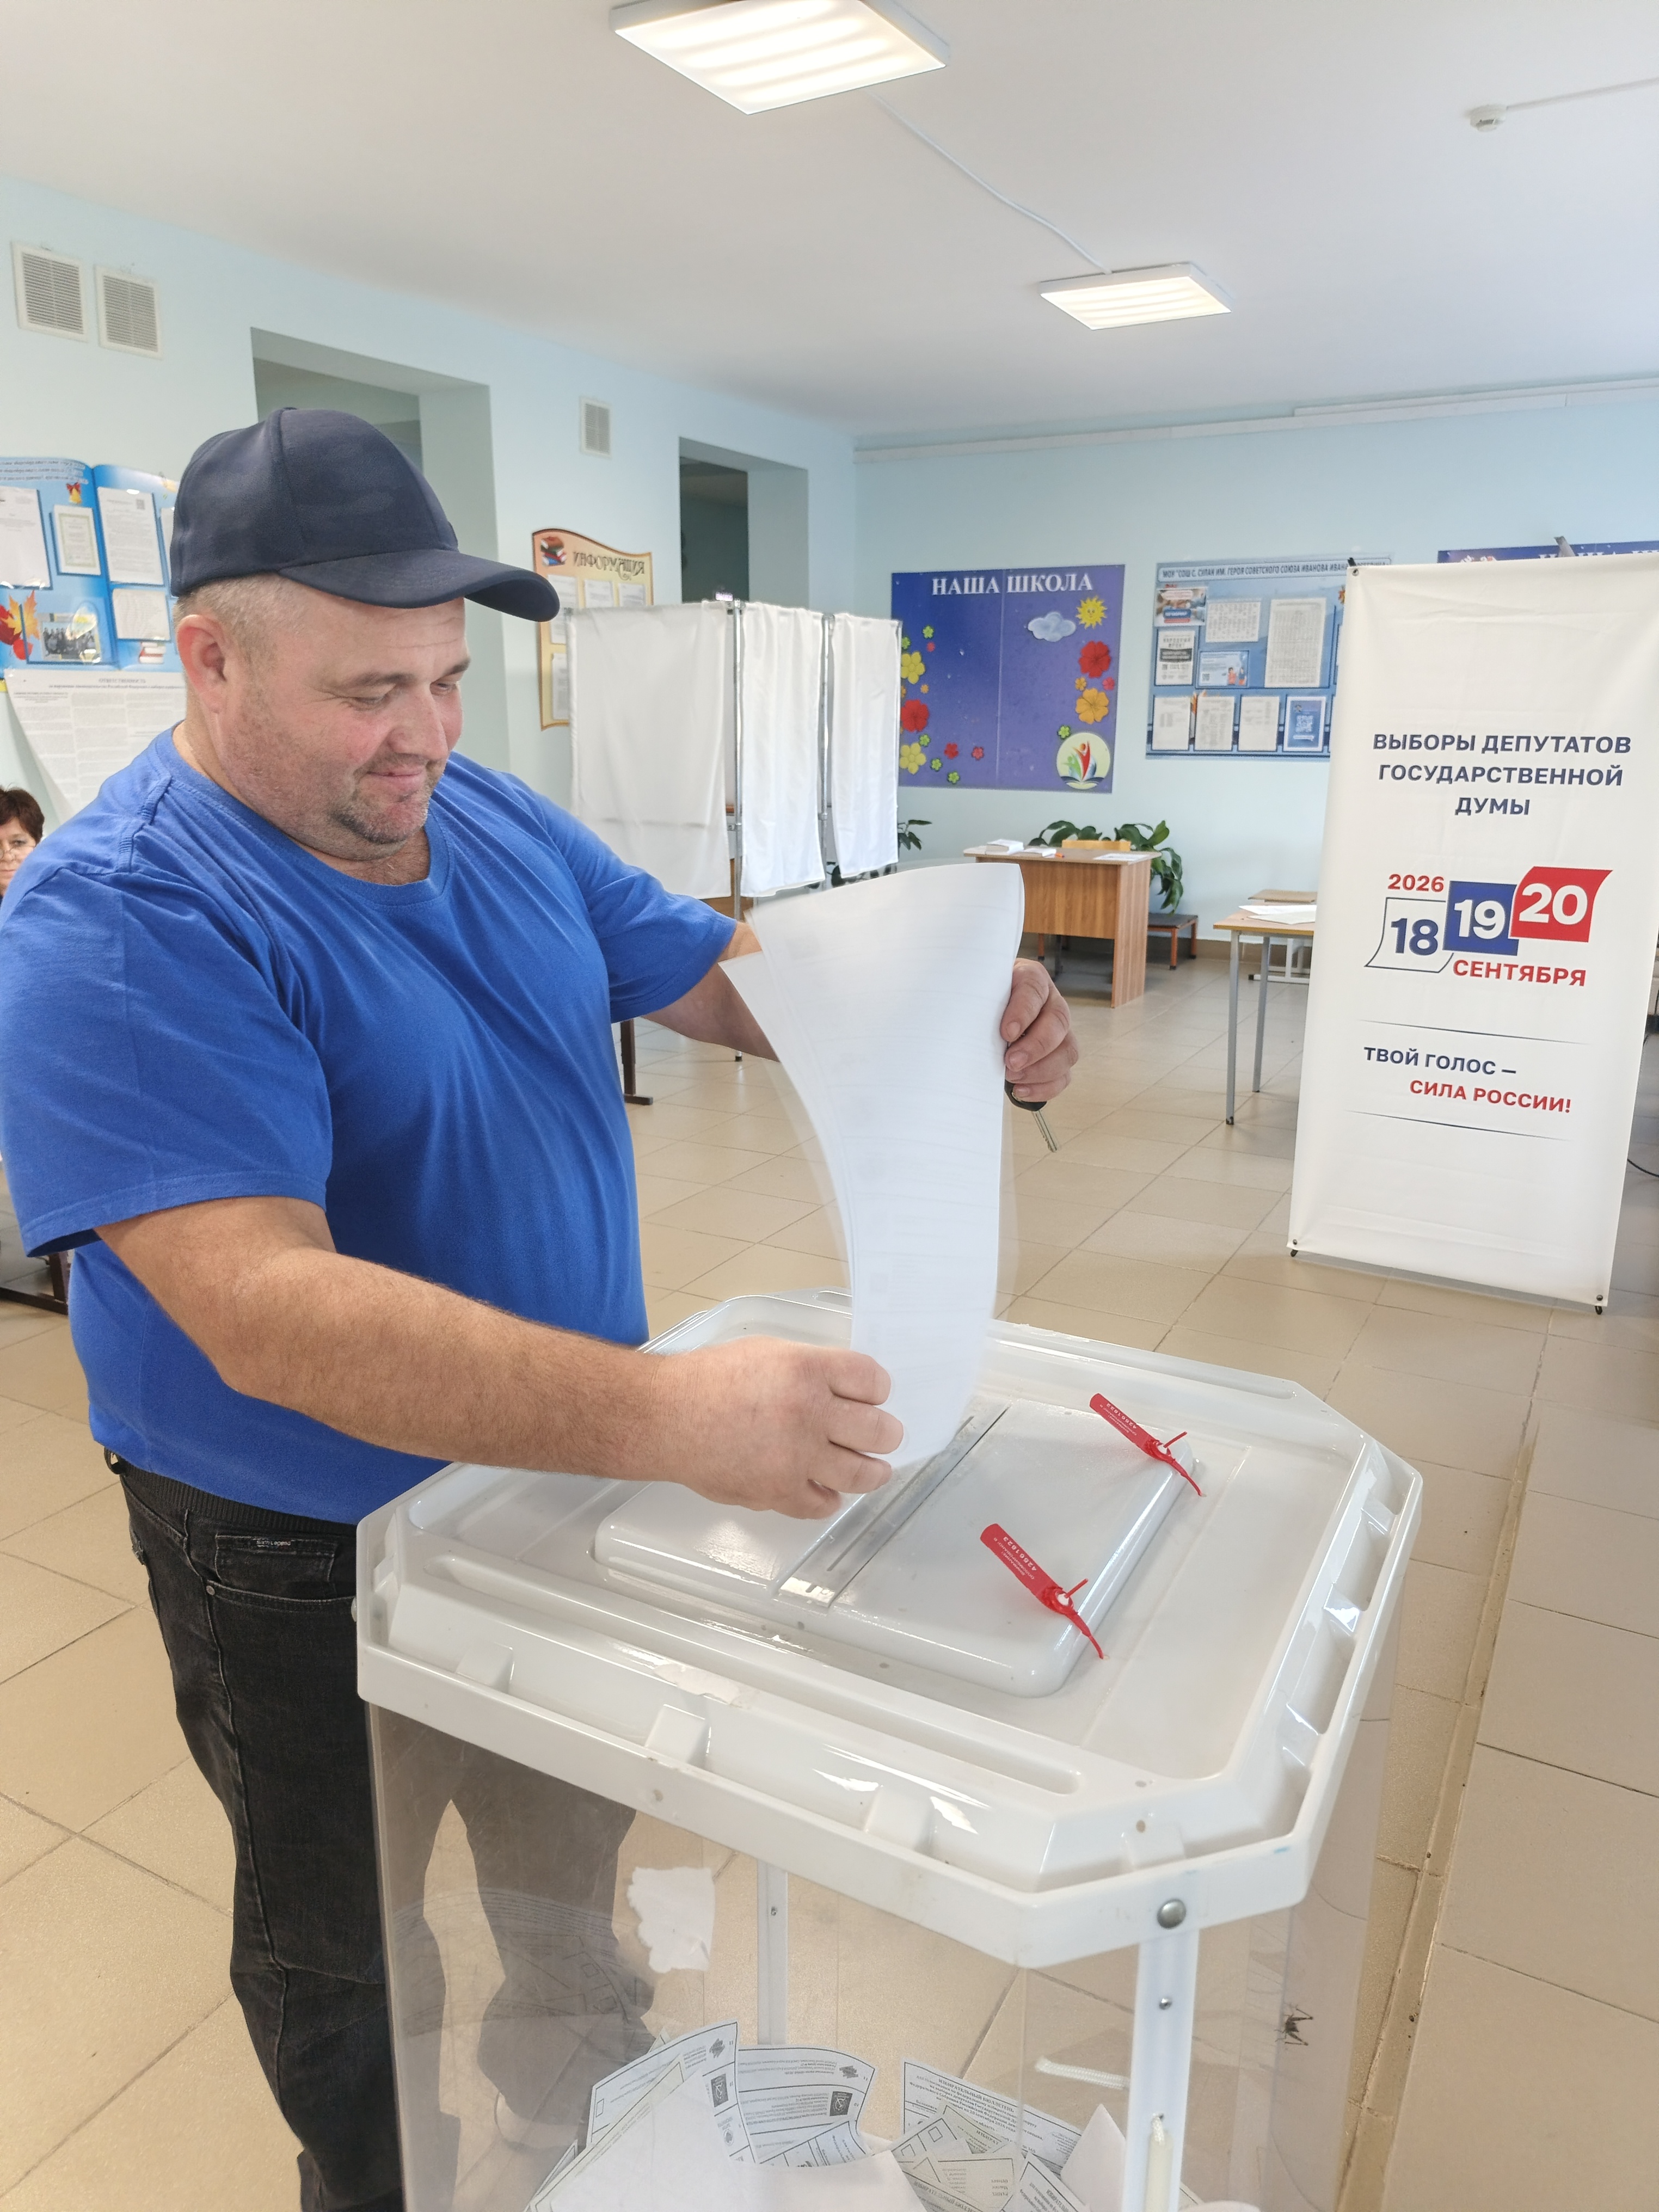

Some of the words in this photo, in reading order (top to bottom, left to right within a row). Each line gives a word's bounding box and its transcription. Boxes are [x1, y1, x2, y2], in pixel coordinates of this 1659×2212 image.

[573, 551, 644, 580] ИНФОРМАЦИЯ
[1227, 567, 1244, 575] ГЕРОЯ
[1245, 564, 1279, 575] СОВЕТСКОГО
[1280, 564, 1300, 574] СОЮЗА
[1301, 563, 1328, 573] ИВАНОВА
[932, 577, 1000, 595] НАША
[1007, 573, 1093, 593] ШКОЛА
[1373, 734, 1476, 751] ВЫБОРЫ
[1481, 735, 1631, 754] ДЕПУТАТОВ
[1379, 764, 1623, 786] ГОСУДАРСТВЕННОЙ
[1454, 797, 1530, 816] ДУМЫ
[1387, 874, 1445, 893] 2026
[1391, 918, 1439, 956] 18
[1454, 899, 1507, 940] 19
[1517, 883, 1588, 925] 20
[1453, 960, 1587, 986] СЕНТЯБРЯ
[1363, 1047, 1419, 1067] ТВОЙ
[1424, 1054, 1496, 1075] ГОЛОС
[1410, 1080, 1466, 1100] СИЛА
[1473, 1088, 1571, 1113] РОССИИ!
[1001, 1551, 1026, 1576] ВНИМАНИЕ!
[938, 2078, 982, 2101] ИЗБИРАТЕЛЬНЫЙ
[983, 2097, 1014, 2112] БЮЛЛЕТЕНЬ
[959, 2100, 983, 2114] Российской
[984, 2111, 1007, 2124] Федерации
[975, 2102, 1011, 2122] Государственной
[975, 2112, 995, 2124] сентября
[987, 2103, 1017, 2118] избирательно
[976, 2129, 999, 2146] ИЗБИРАТ
